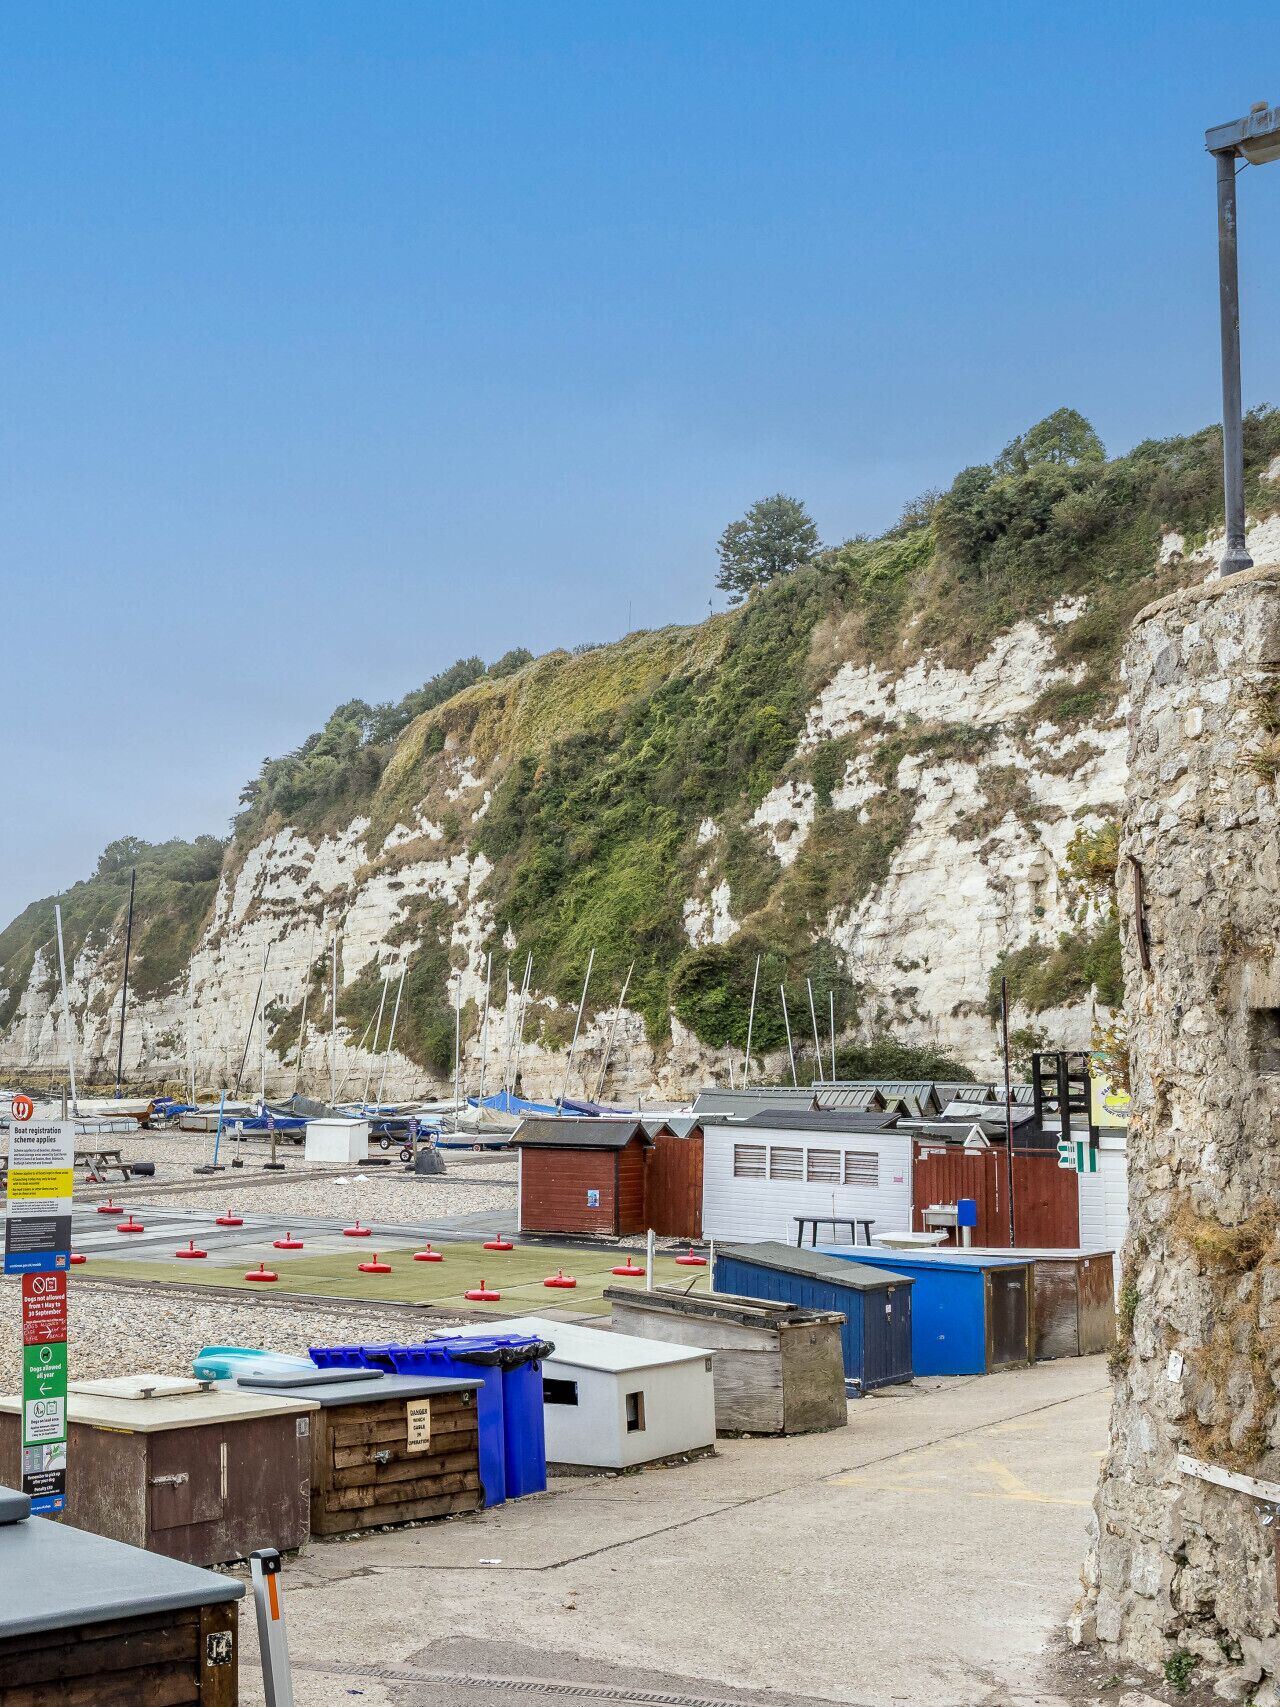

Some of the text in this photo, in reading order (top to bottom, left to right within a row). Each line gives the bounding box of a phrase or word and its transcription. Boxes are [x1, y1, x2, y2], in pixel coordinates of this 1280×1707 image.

[28, 1126, 62, 1136] registration
[14, 1136, 56, 1145] scheme applies
[46, 1293, 65, 1301] allowed
[35, 1309, 62, 1317] September
[43, 1363, 62, 1371] allowed
[43, 1372, 55, 1380] year
[410, 1408, 428, 1416] DANGER
[408, 1438, 430, 1446] OPERATION
[213, 1639, 227, 1658] 14
